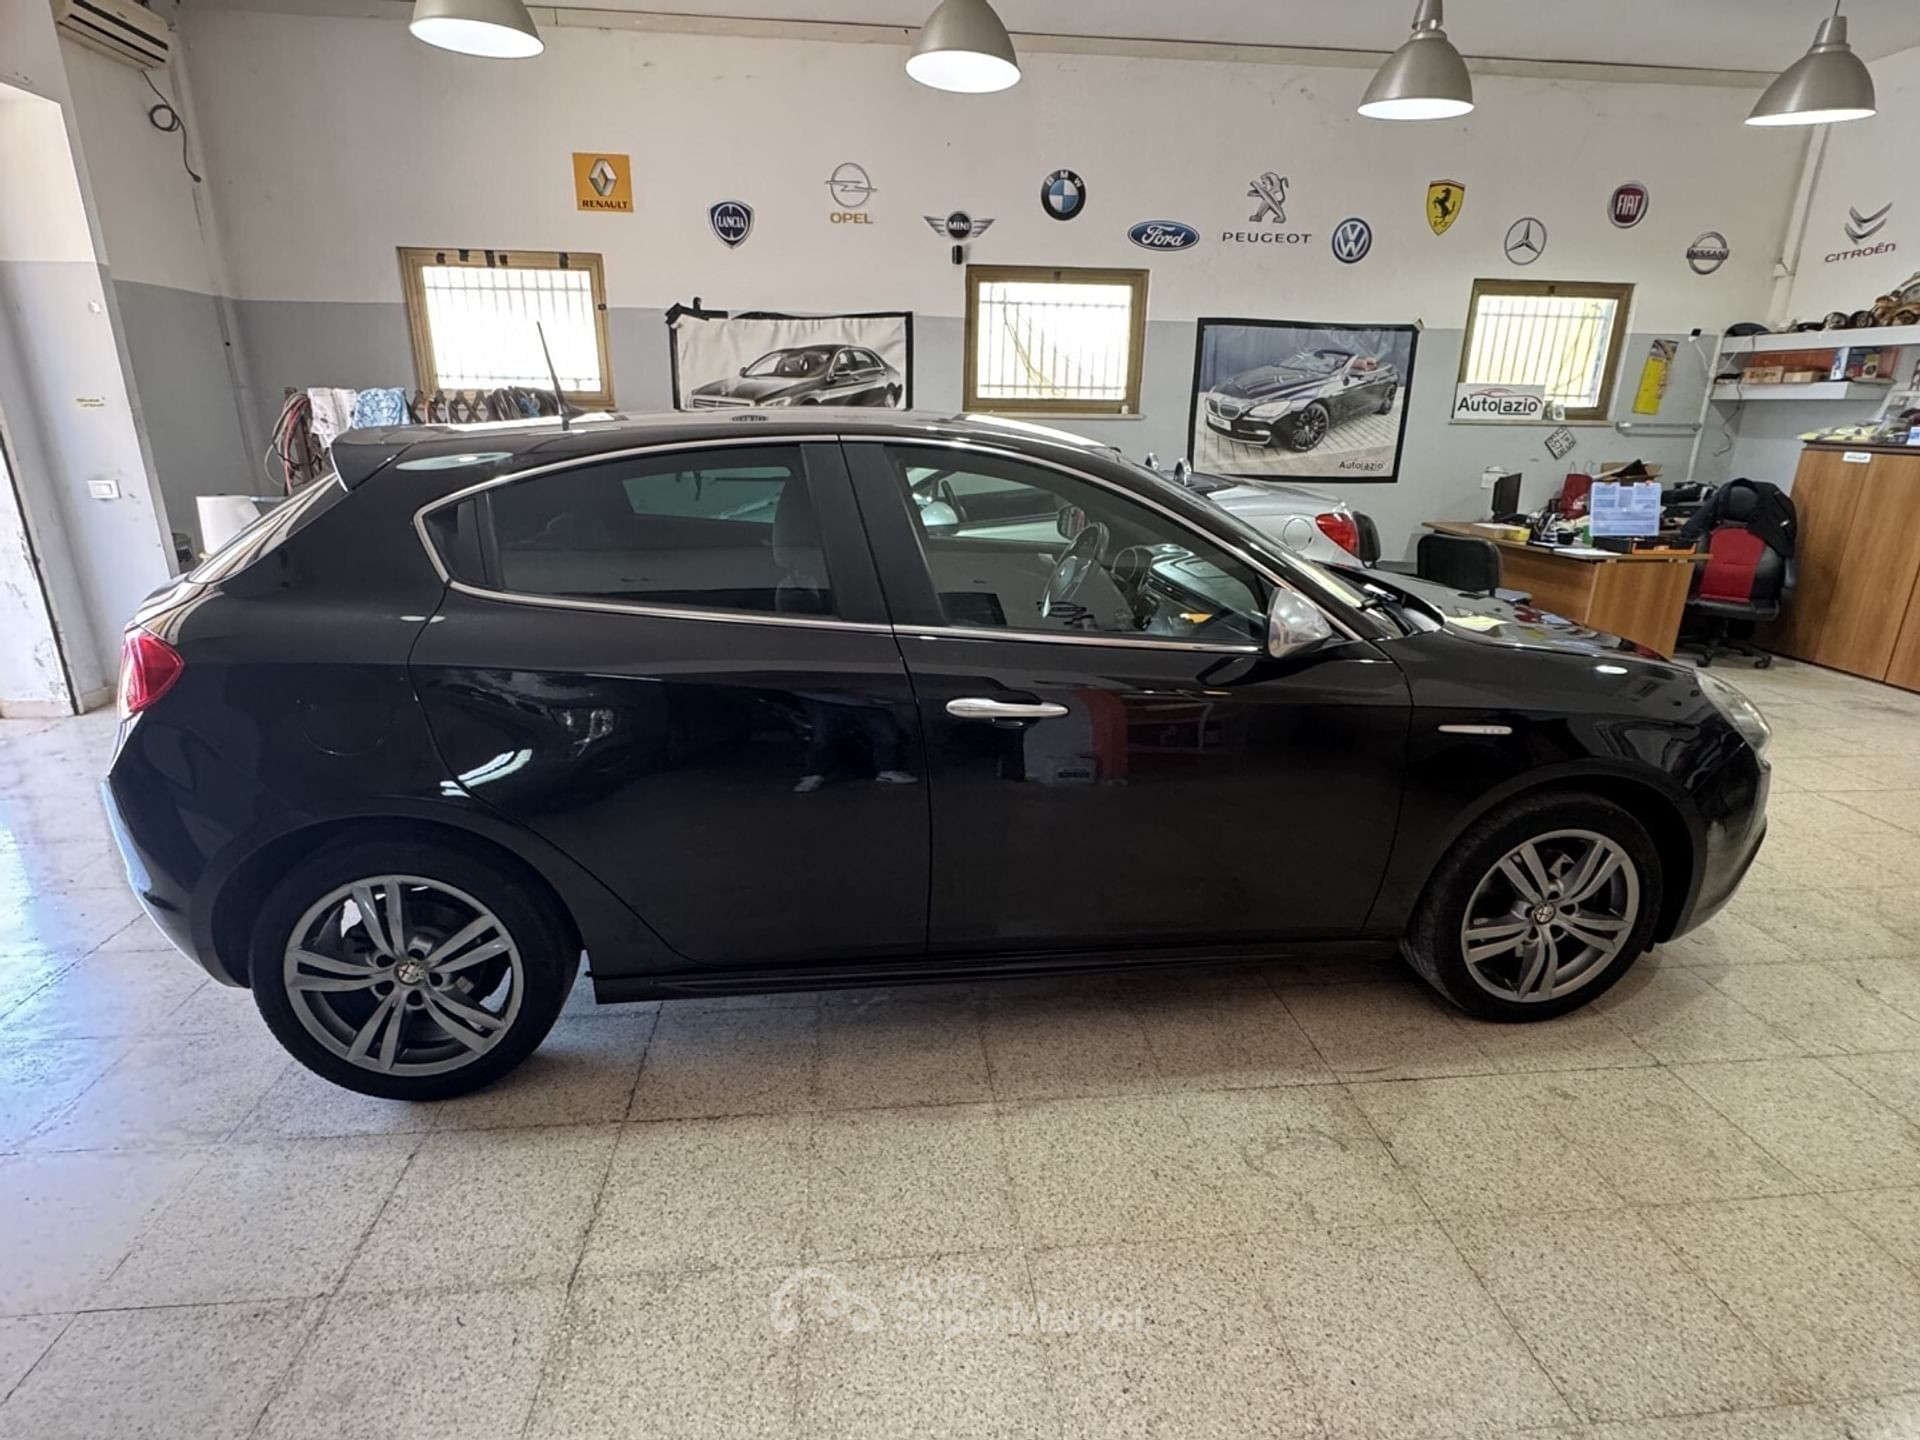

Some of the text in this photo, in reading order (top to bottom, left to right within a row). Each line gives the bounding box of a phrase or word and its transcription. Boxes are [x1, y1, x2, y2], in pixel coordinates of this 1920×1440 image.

[582, 199, 628, 209] RENAULT
[1616, 194, 1641, 216] FIAT
[718, 215, 745, 228] LANCIA
[830, 212, 873, 224] OPEL
[948, 221, 971, 231] MINI
[1142, 225, 1186, 246] Ford
[1222, 231, 1312, 244] PEUGEOT
[1691, 248, 1726, 258] NISSAN
[1457, 396, 1538, 416] AutoLazio
